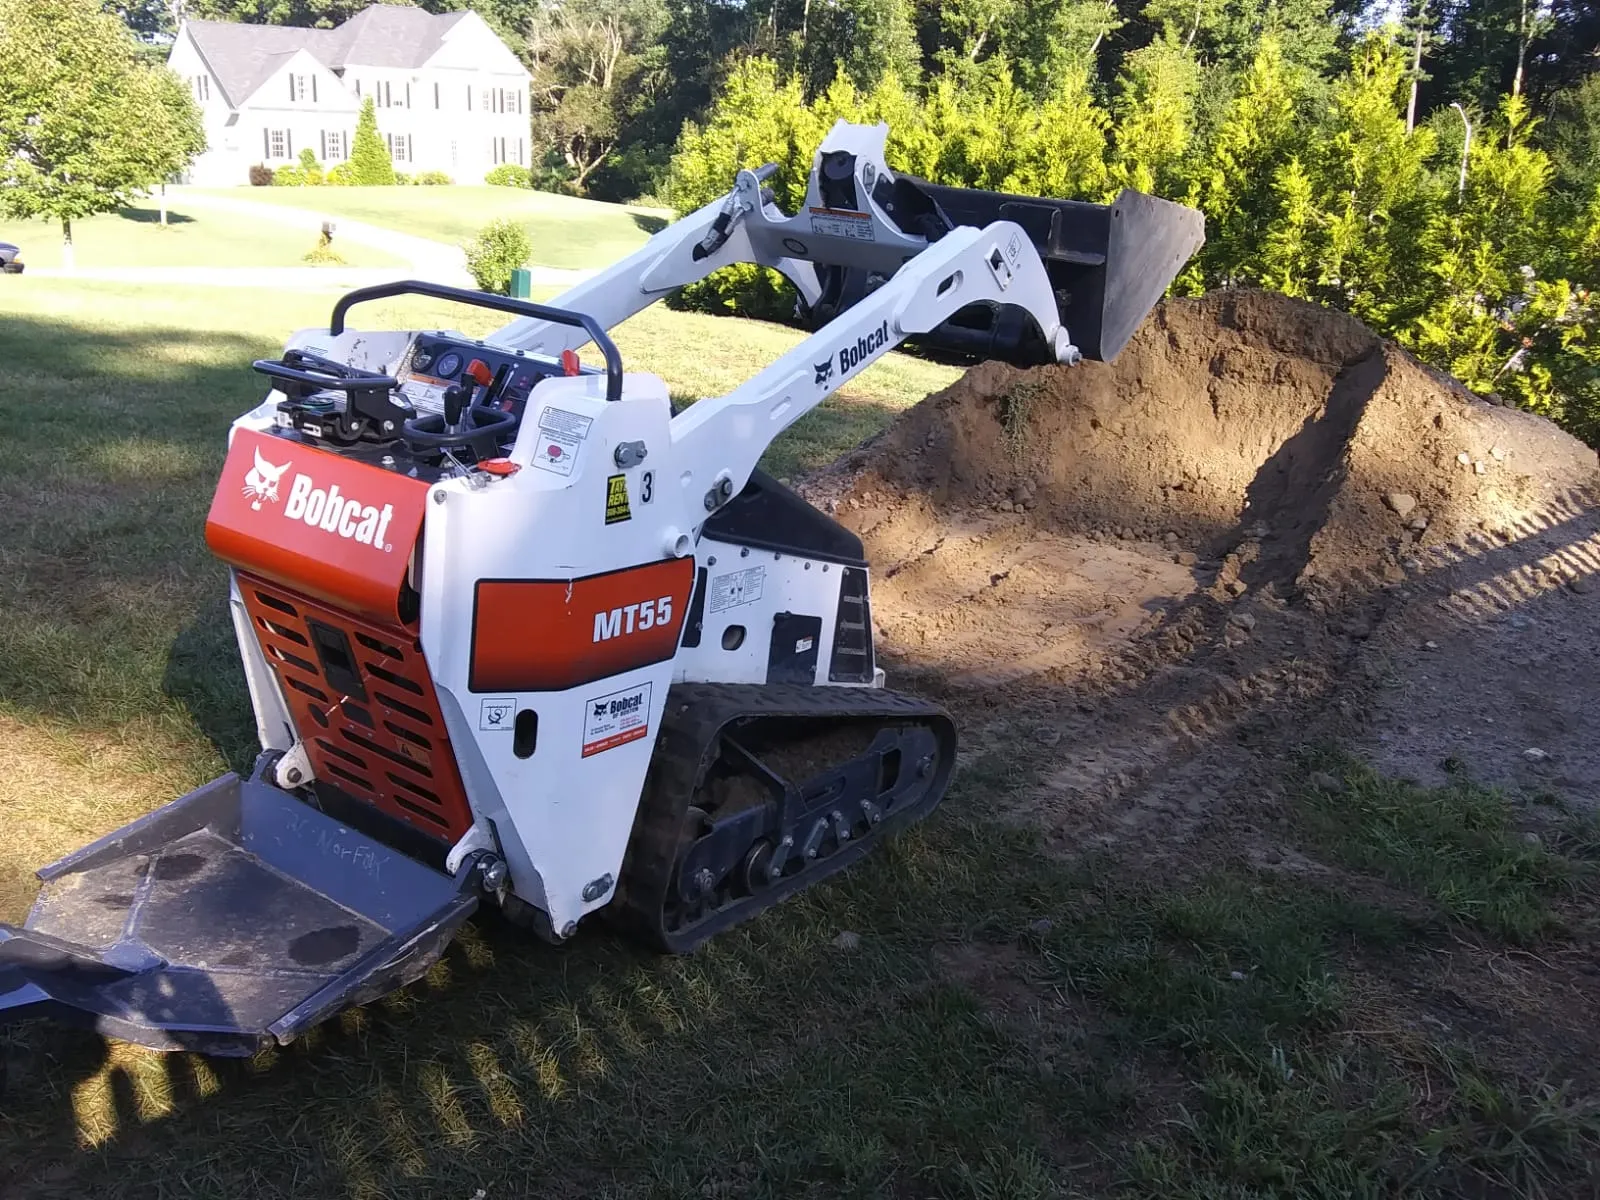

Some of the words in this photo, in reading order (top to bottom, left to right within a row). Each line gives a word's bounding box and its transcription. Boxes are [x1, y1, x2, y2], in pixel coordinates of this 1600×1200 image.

[839, 320, 889, 375] Bobcat
[642, 472, 652, 503] 3
[284, 473, 393, 551] Bobcat
[593, 596, 672, 643] MT55
[610, 692, 642, 714] Bobcat
